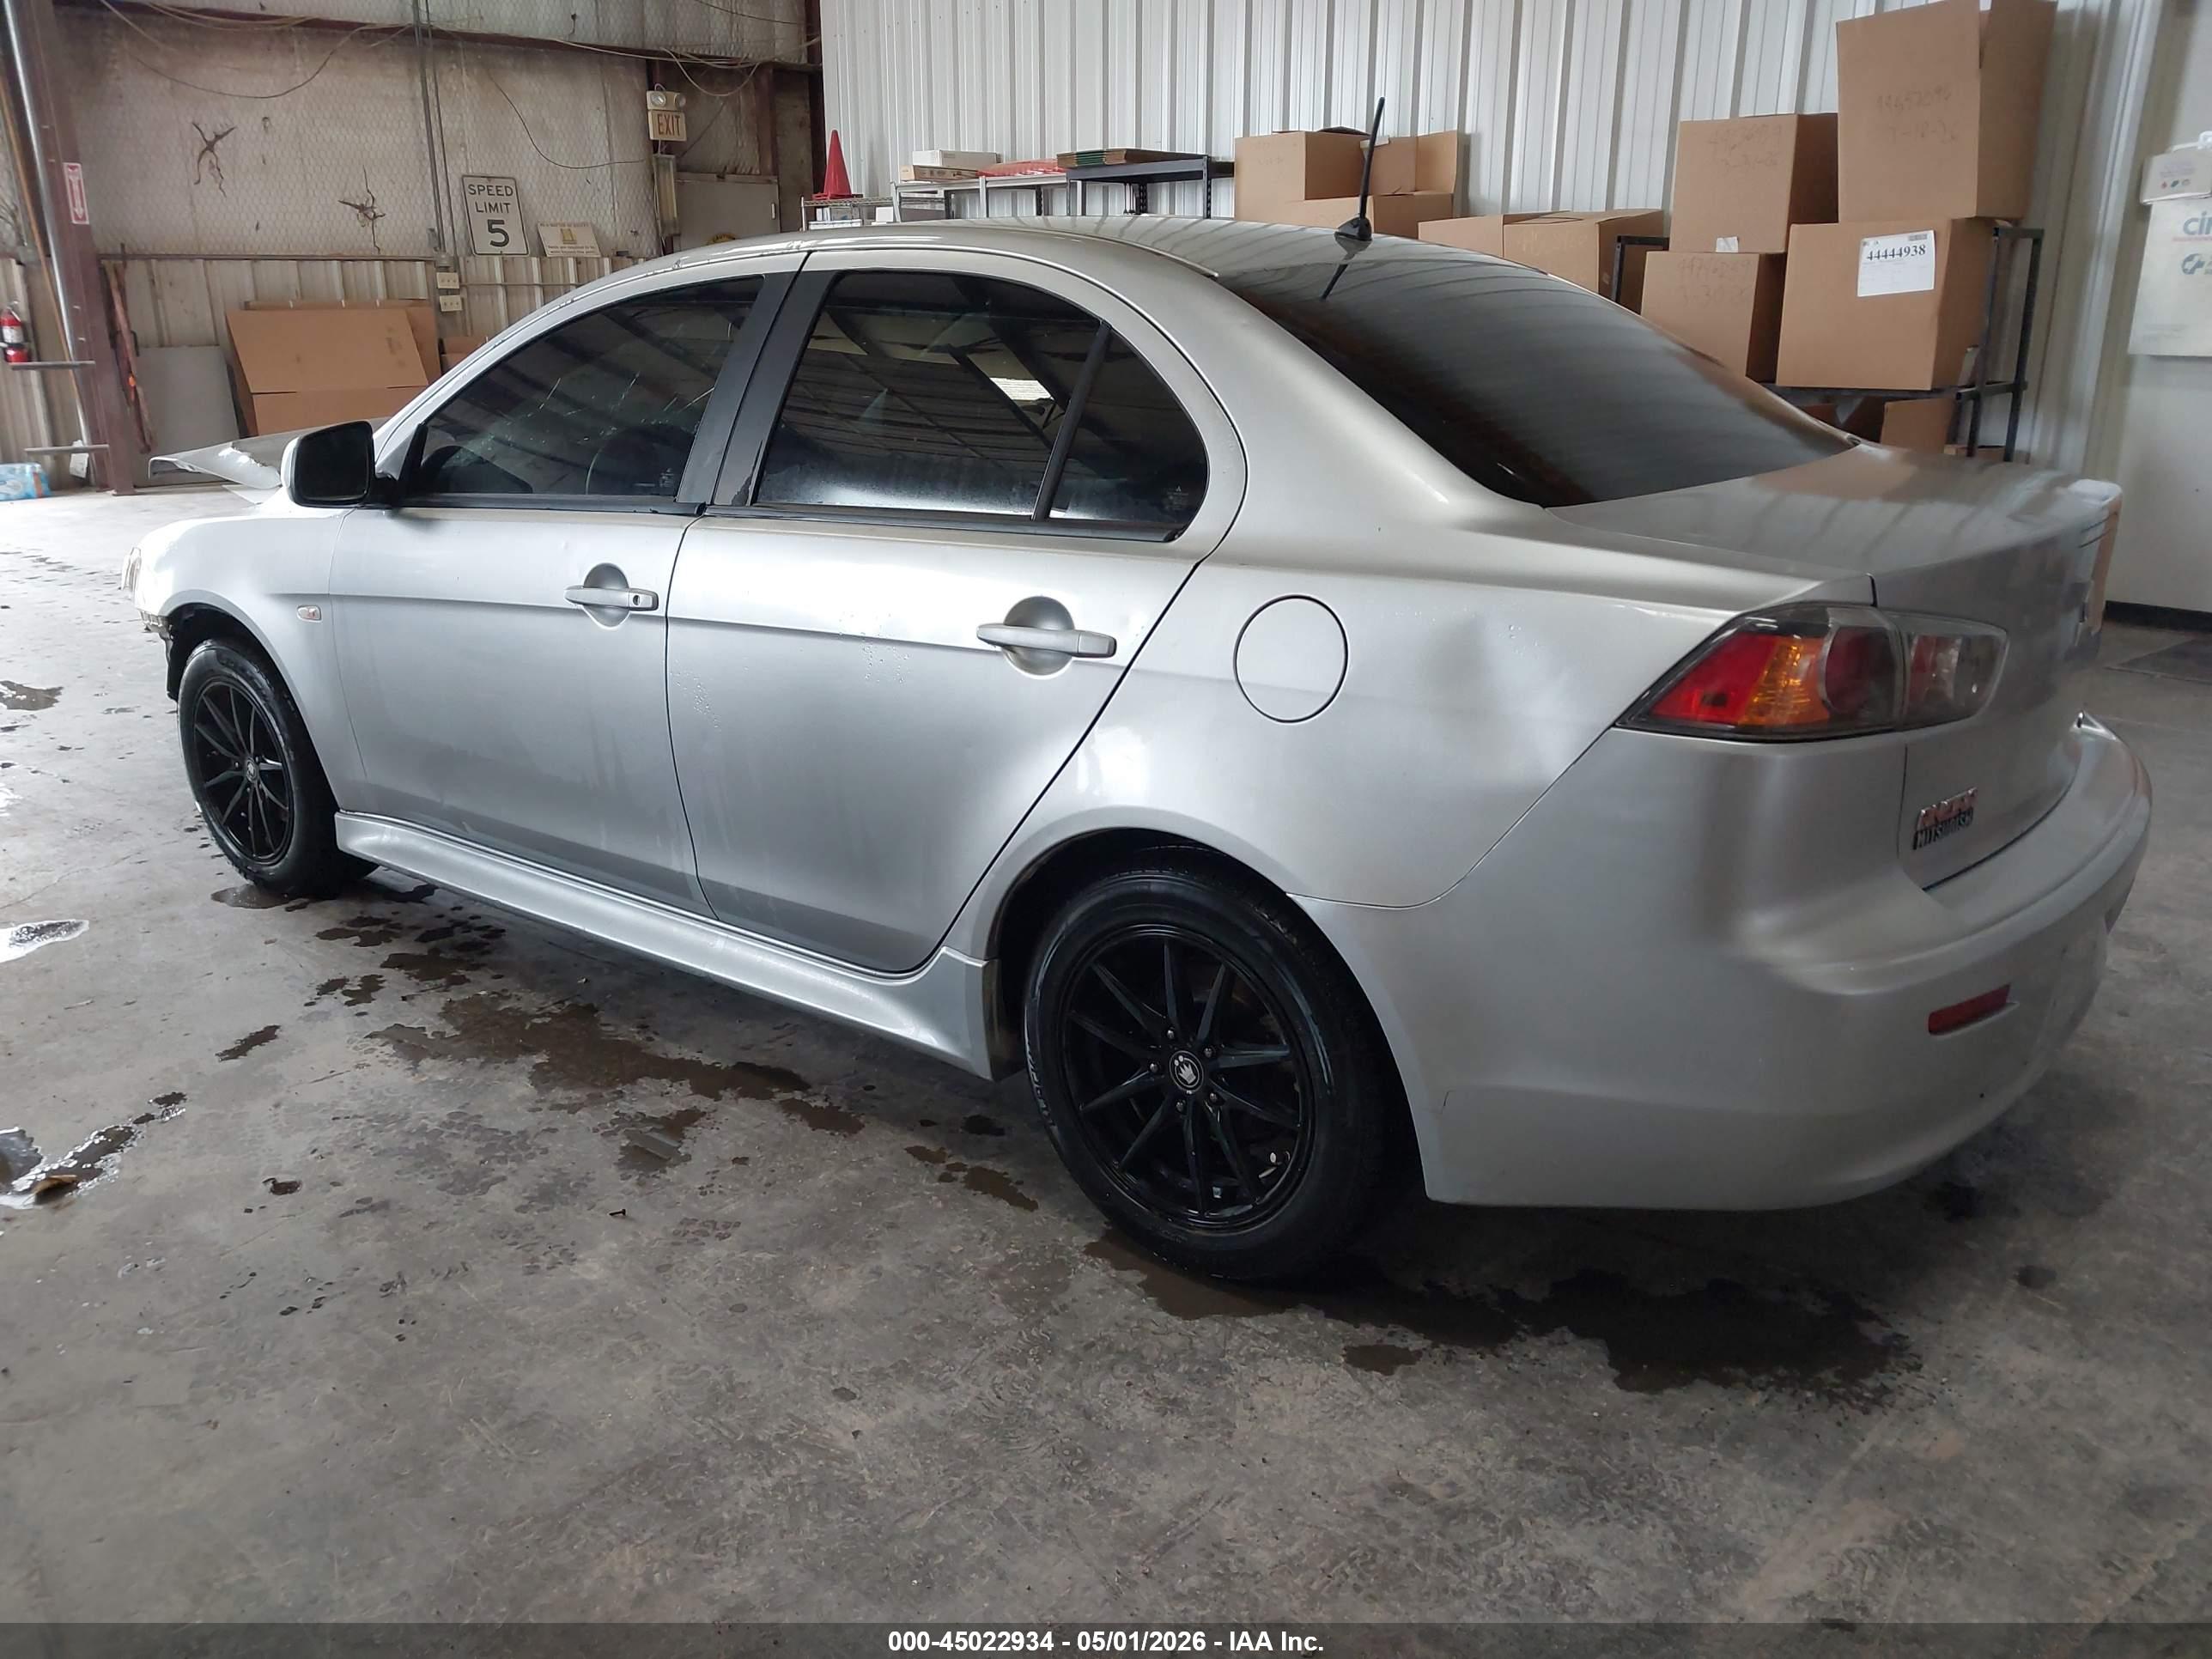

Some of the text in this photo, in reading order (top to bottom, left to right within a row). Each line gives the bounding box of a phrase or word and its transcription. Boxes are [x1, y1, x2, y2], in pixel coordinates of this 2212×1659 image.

[657, 113, 680, 136] EXIT
[468, 184, 514, 197] SPEED
[475, 201, 511, 213] LIMIT
[487, 219, 509, 247] 5
[1866, 244, 1927, 261] 44444938
